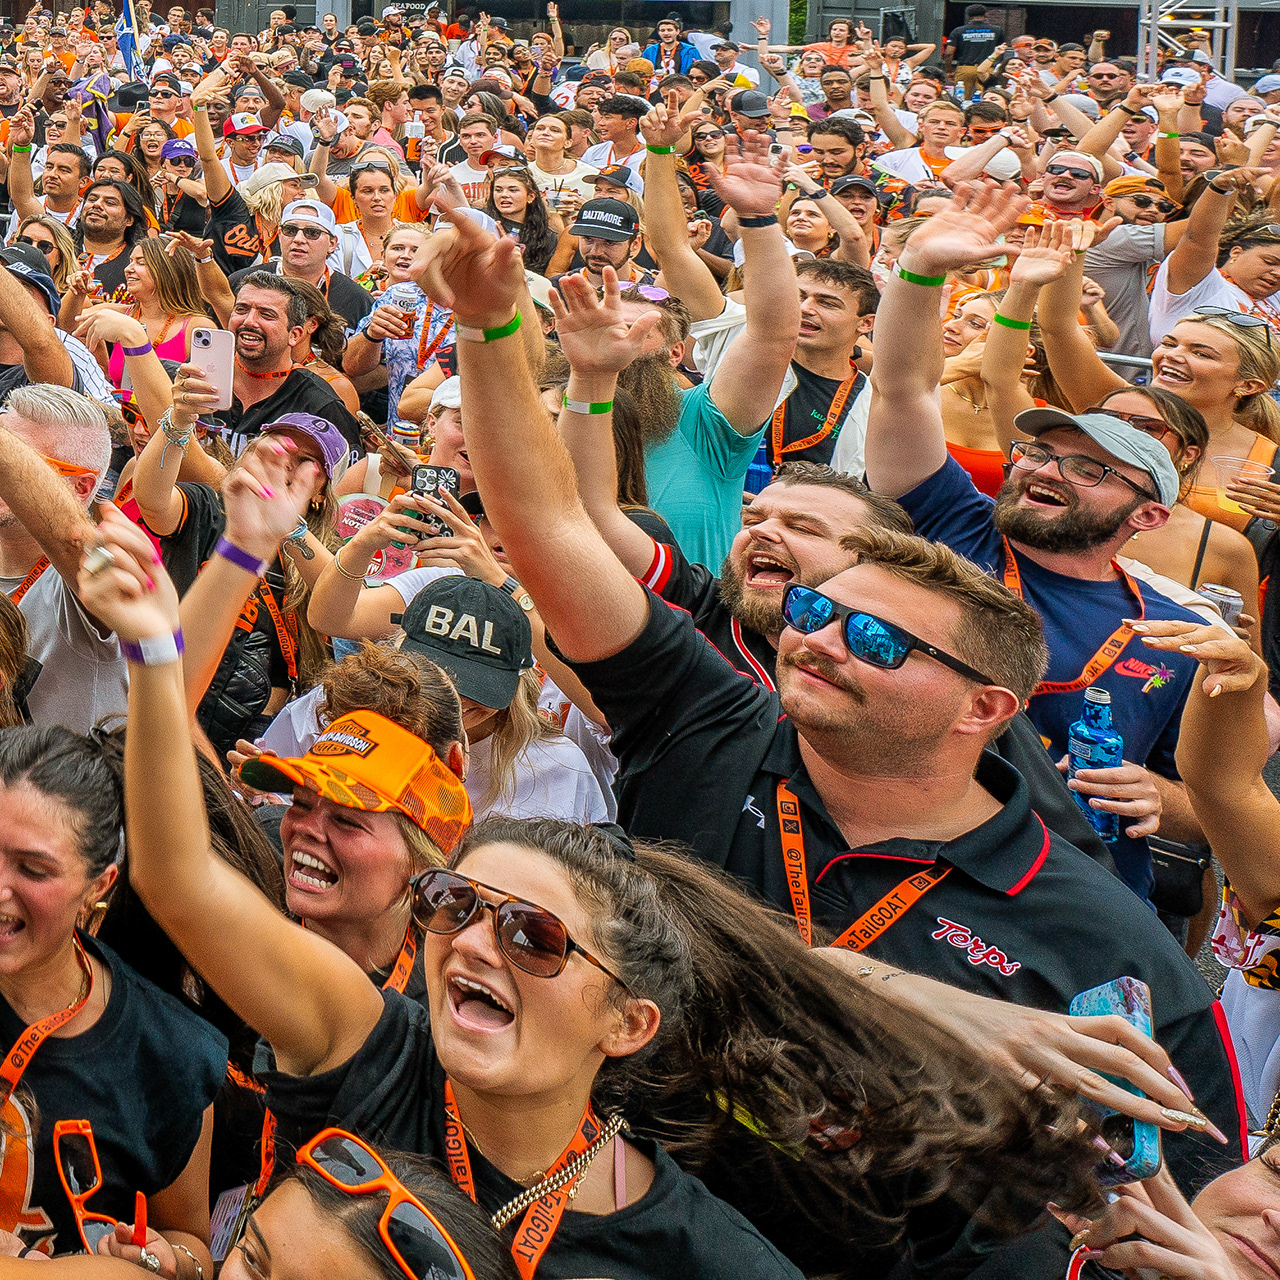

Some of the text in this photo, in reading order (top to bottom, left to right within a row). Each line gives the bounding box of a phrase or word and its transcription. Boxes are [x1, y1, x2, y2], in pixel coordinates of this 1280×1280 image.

[582, 209, 624, 227] BALTIMORE
[424, 604, 502, 655] BAL
[845, 891, 909, 950] eTailGOAT
[931, 916, 1022, 976] Terps
